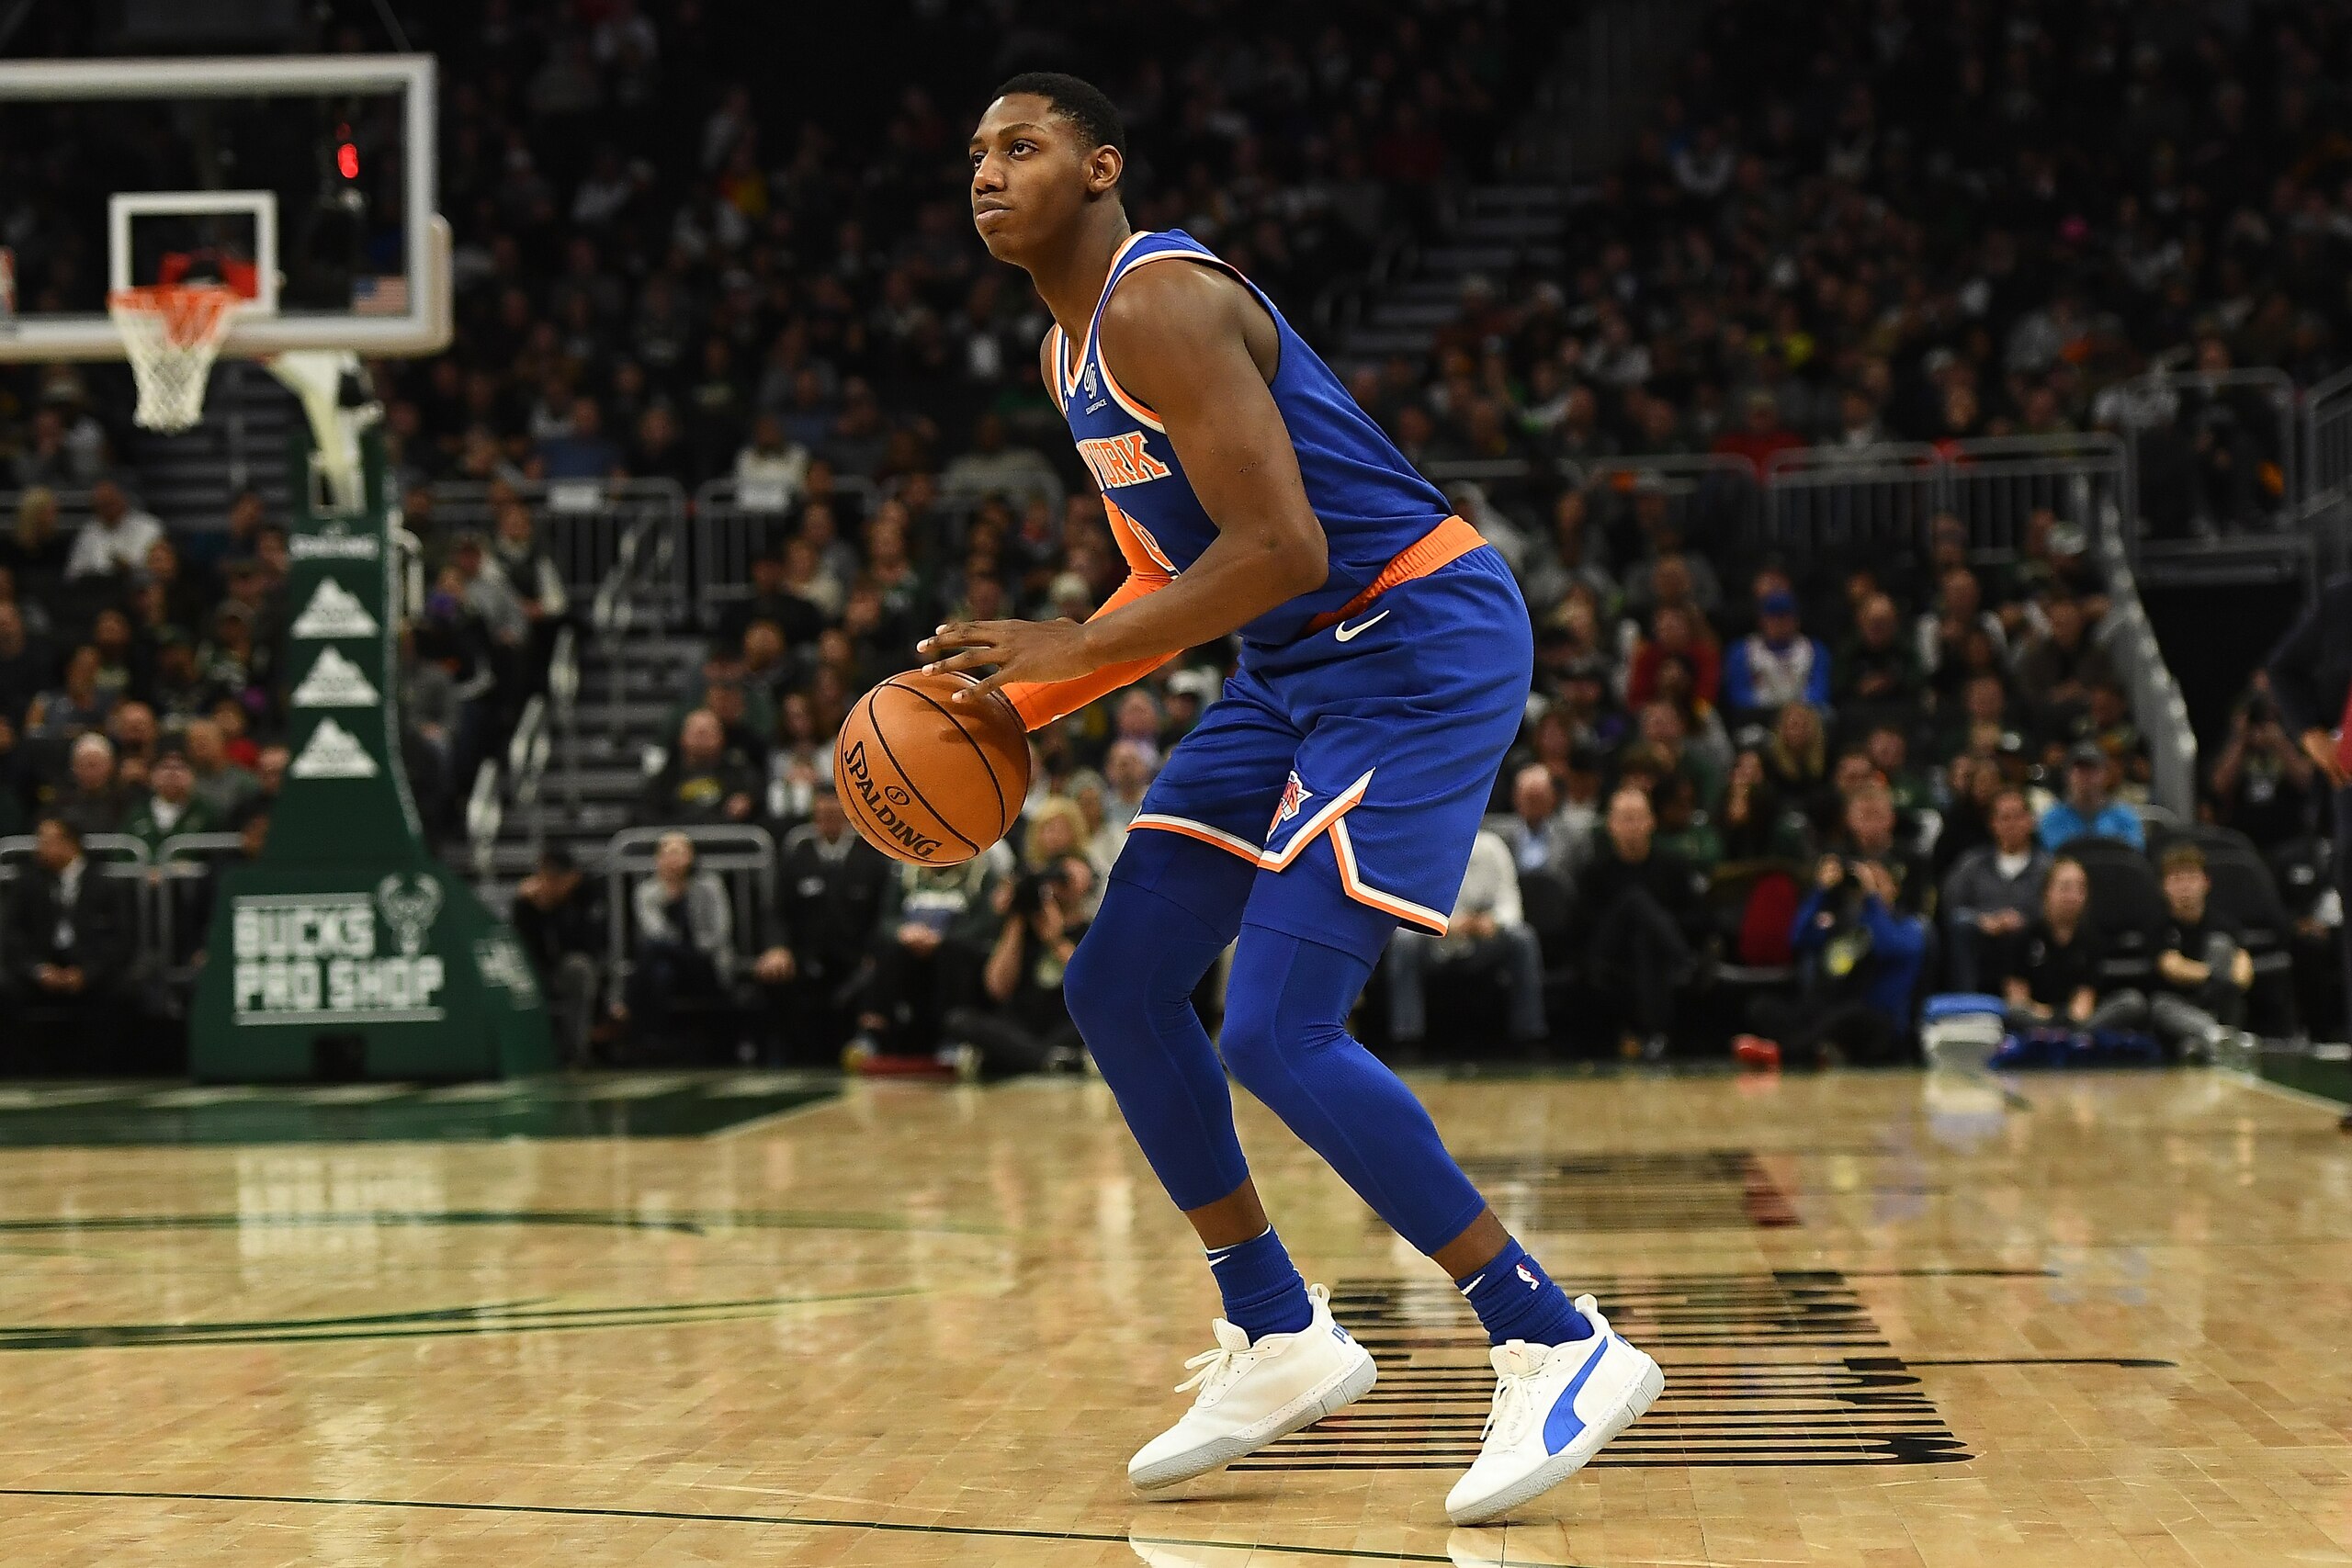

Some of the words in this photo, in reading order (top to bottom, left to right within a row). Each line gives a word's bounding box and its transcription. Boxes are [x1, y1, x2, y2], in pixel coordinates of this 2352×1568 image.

[844, 740, 943, 859] SPALDING
[233, 908, 375, 957] BUCKS
[233, 961, 322, 1010] PRO
[328, 956, 445, 1009] SHOP
